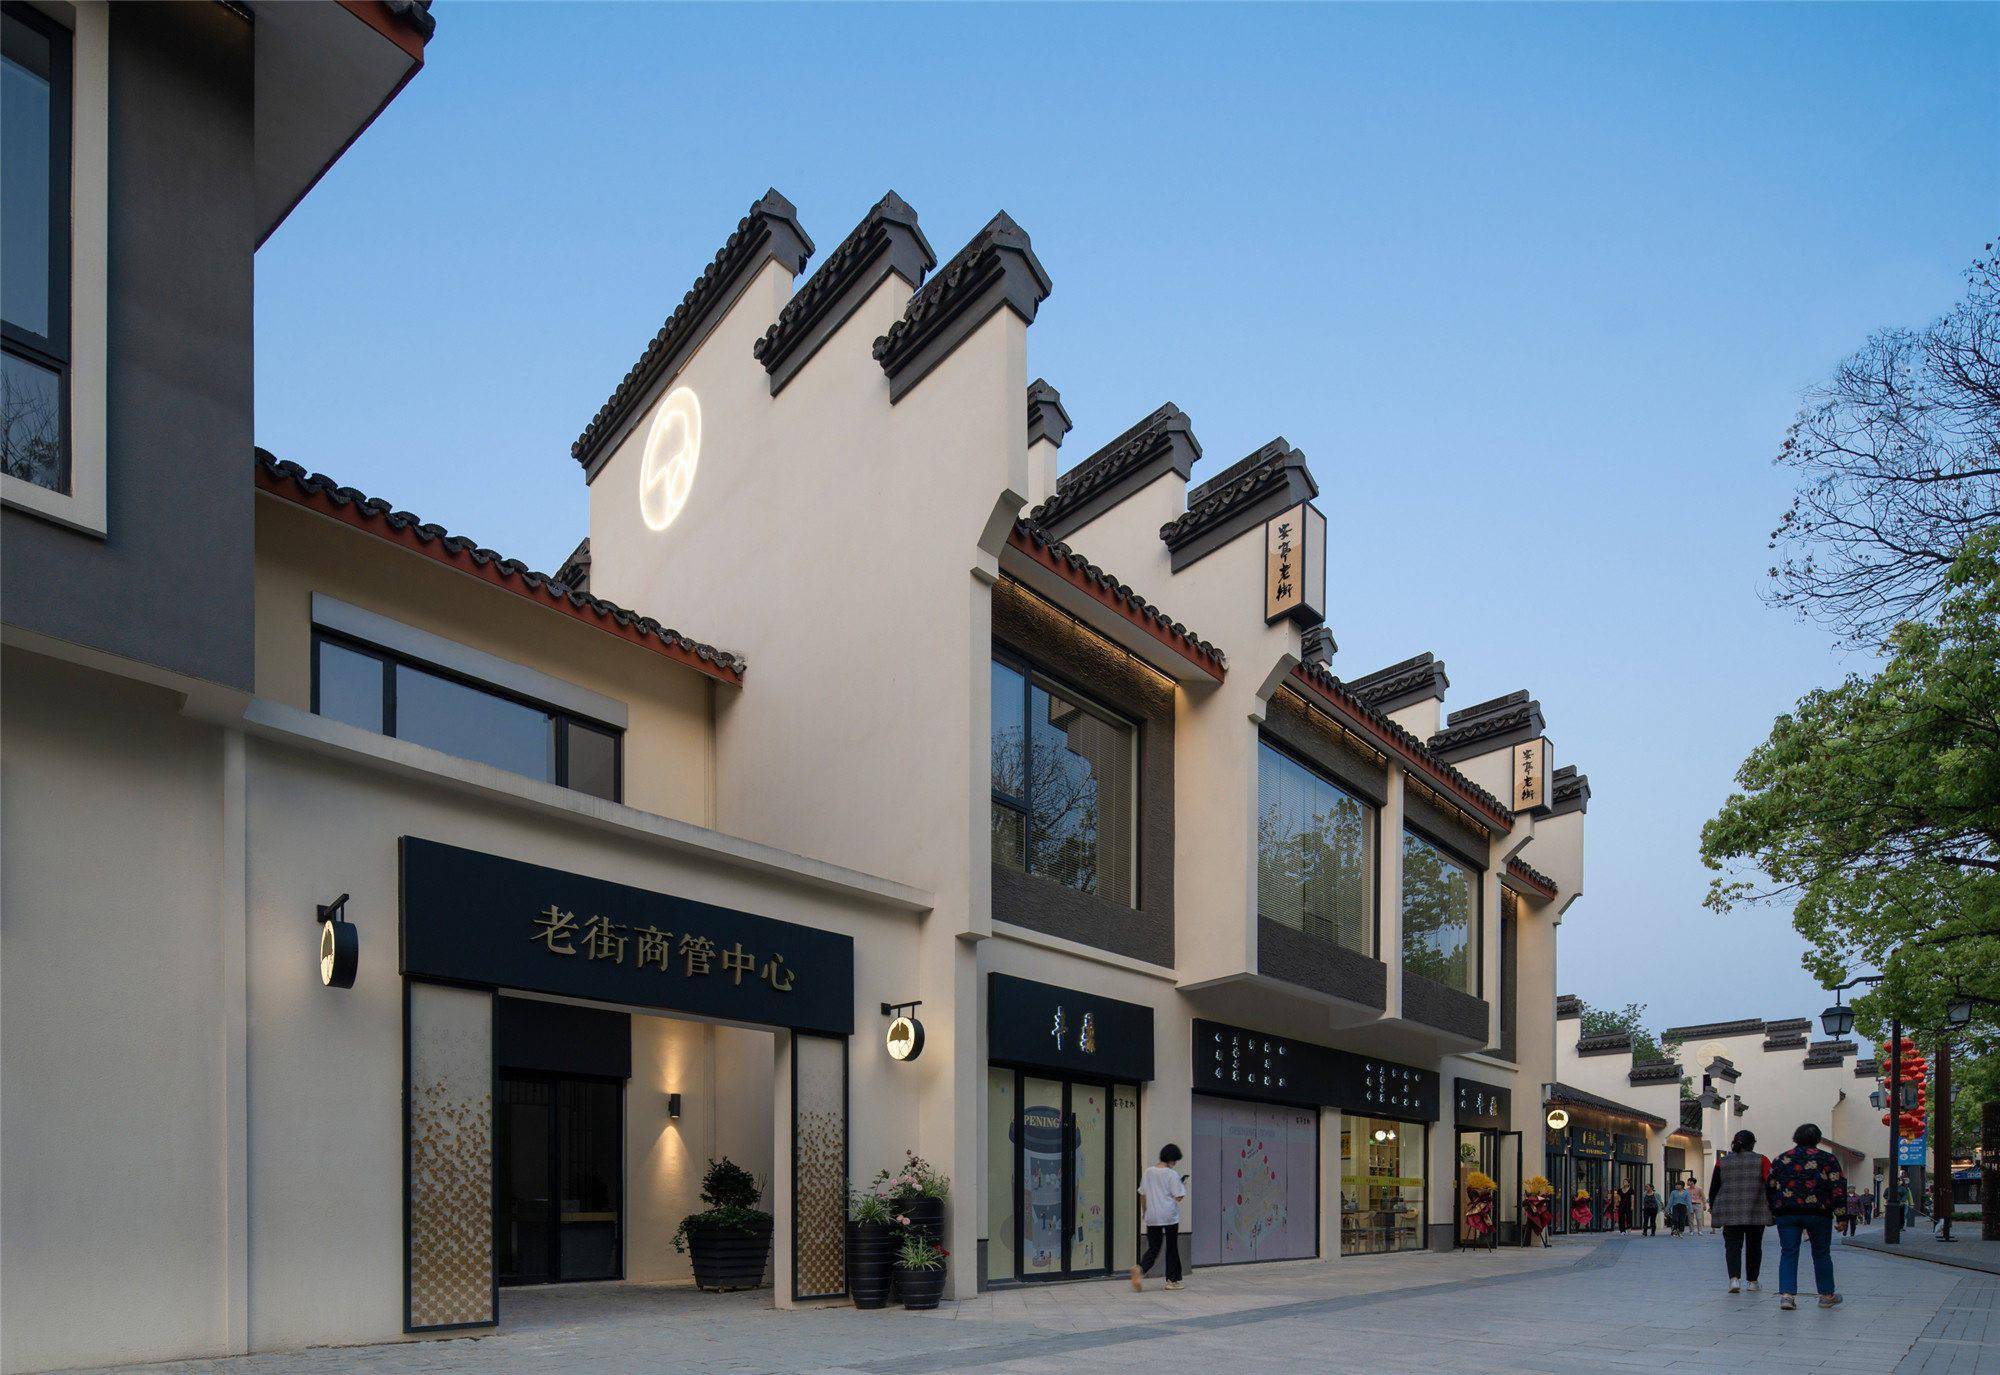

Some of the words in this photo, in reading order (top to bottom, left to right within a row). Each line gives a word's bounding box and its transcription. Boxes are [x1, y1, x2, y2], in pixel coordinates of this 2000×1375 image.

[1276, 523, 1293, 601] 安亭老街
[1521, 749, 1535, 801] 安亭老街
[529, 904, 796, 992] 老街商管中心
[1023, 1114, 1060, 1128] PENING
